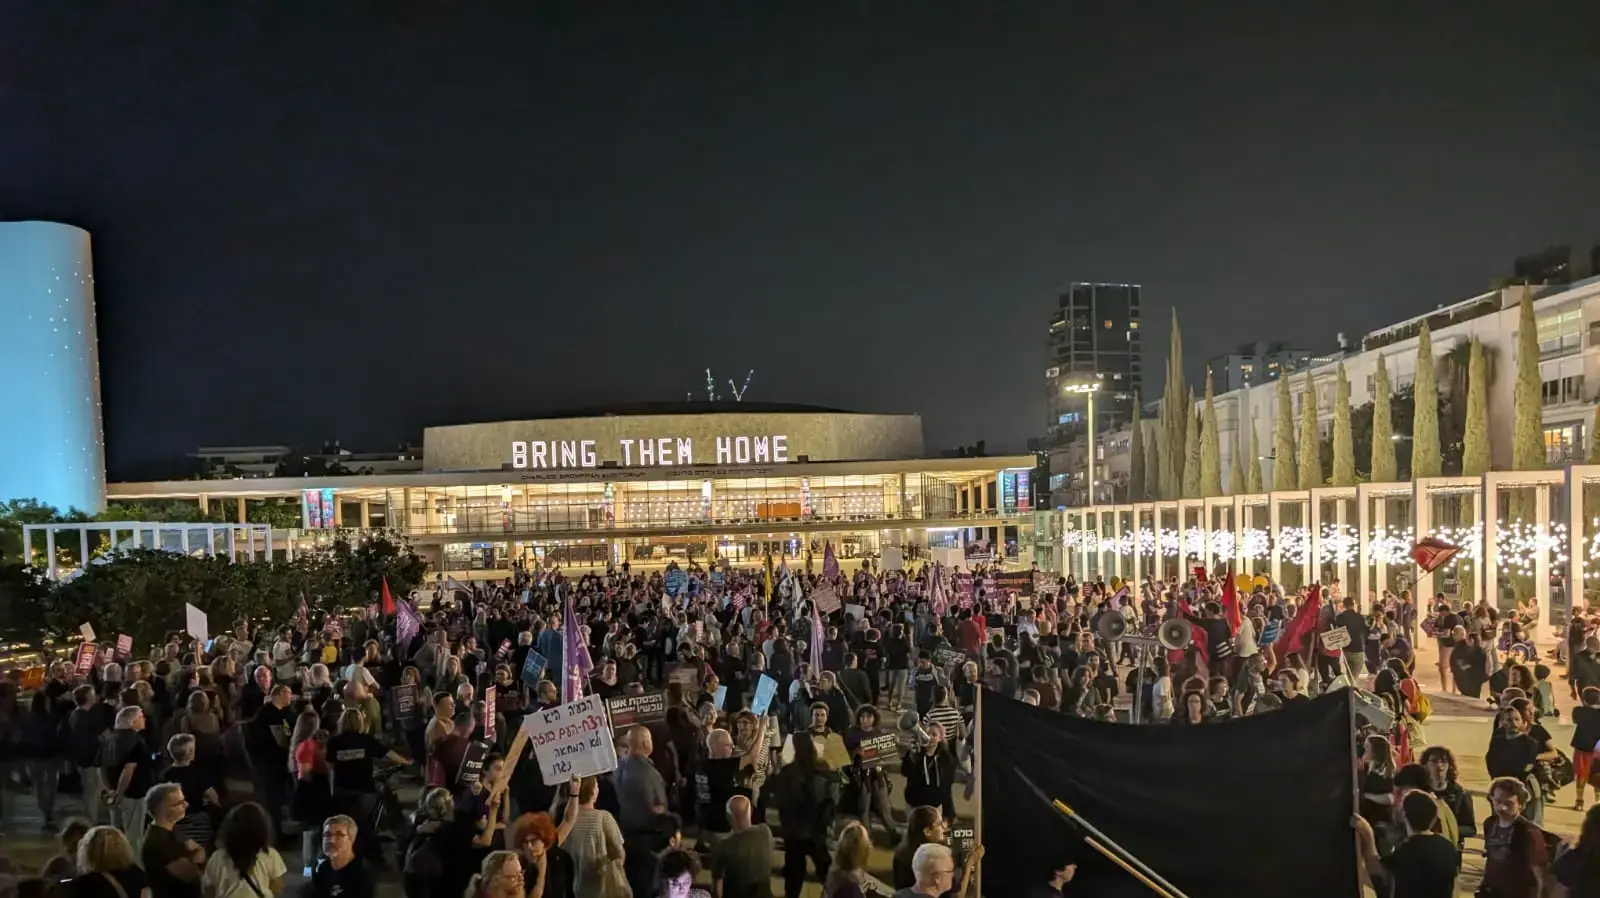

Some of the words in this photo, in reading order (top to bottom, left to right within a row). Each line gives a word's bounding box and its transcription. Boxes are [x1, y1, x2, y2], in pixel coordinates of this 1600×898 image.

[512, 440, 596, 468] BRING
[620, 438, 692, 466] THEM
[717, 434, 788, 463] HOME
[568, 700, 593, 717] הבעיה
[611, 698, 626, 709] אש
[629, 694, 662, 711] הפסקת
[544, 711, 560, 724] היא
[532, 733, 556, 748] בעזה
[589, 732, 602, 748] ולא
[554, 742, 586, 758] המחאה
